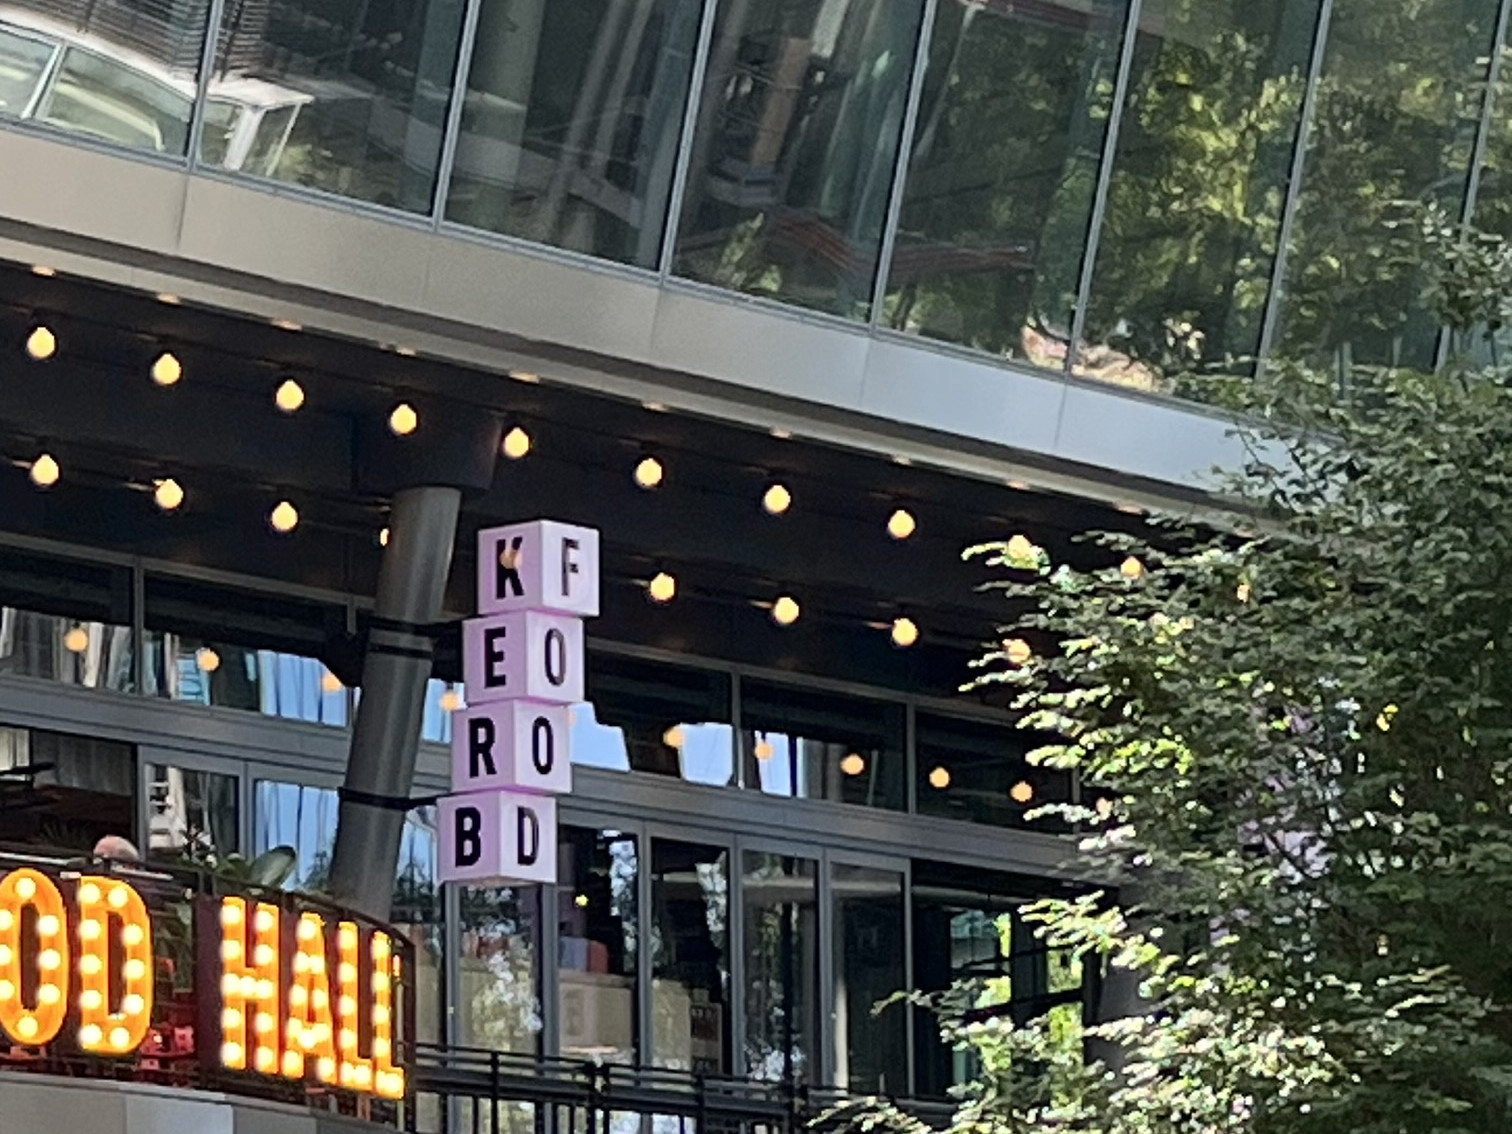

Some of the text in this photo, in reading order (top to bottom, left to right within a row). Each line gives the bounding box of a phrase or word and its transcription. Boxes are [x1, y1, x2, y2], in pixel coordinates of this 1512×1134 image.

[455, 536, 524, 868] KERB
[517, 536, 582, 866] FOOD
[219, 894, 407, 1101] HALL
